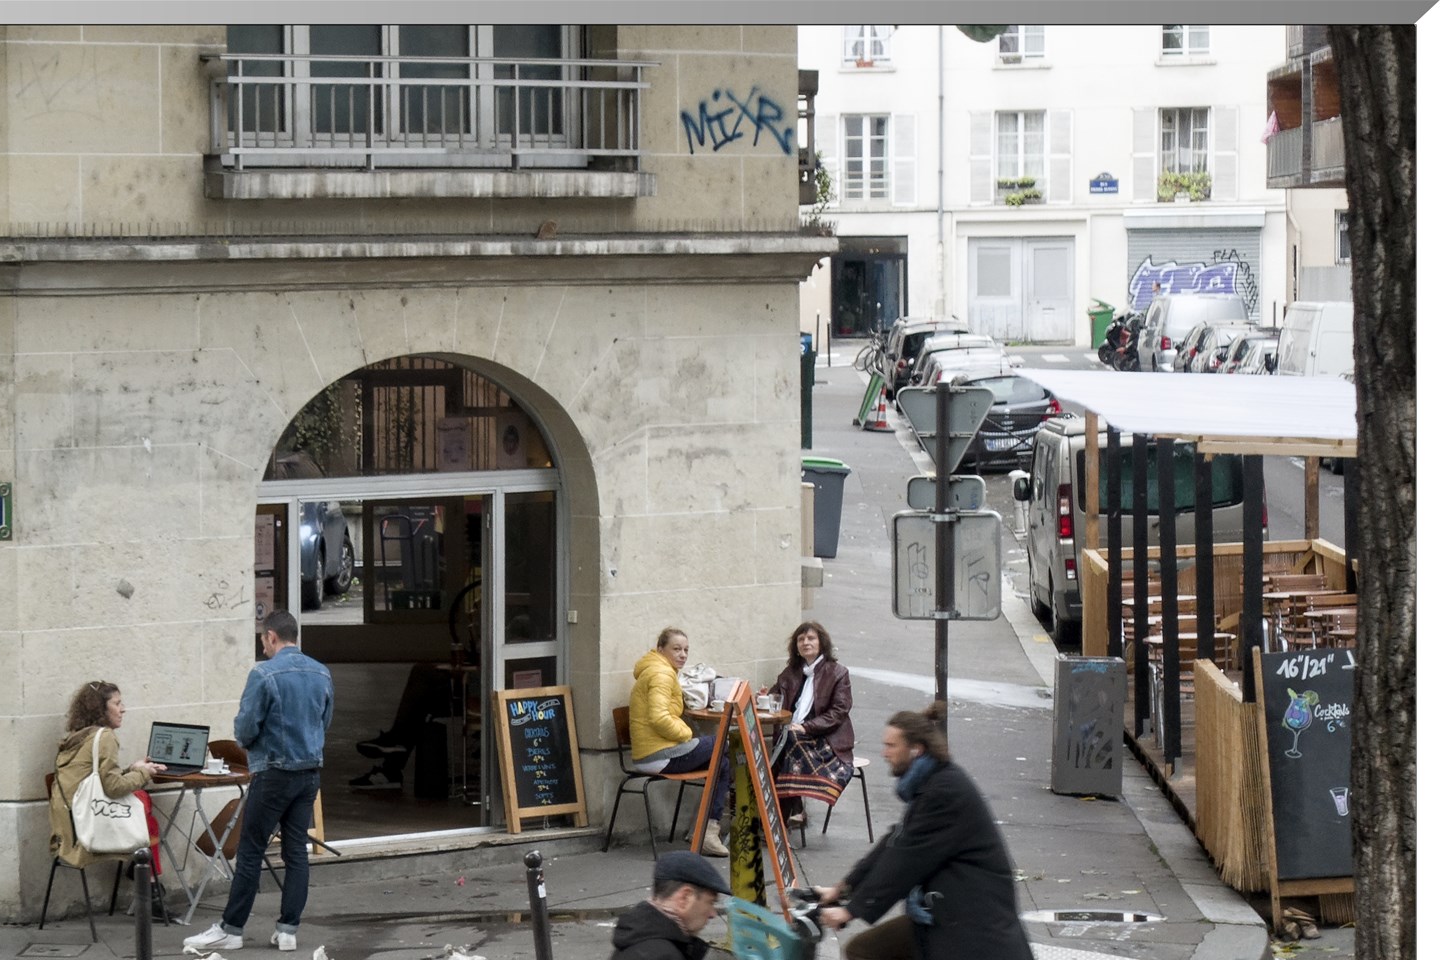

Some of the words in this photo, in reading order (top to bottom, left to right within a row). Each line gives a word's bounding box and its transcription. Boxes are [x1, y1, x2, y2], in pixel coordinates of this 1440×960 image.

[510, 700, 539, 717] HAPPY
[532, 708, 556, 721] HOUR
[91, 798, 132, 819] VICE
